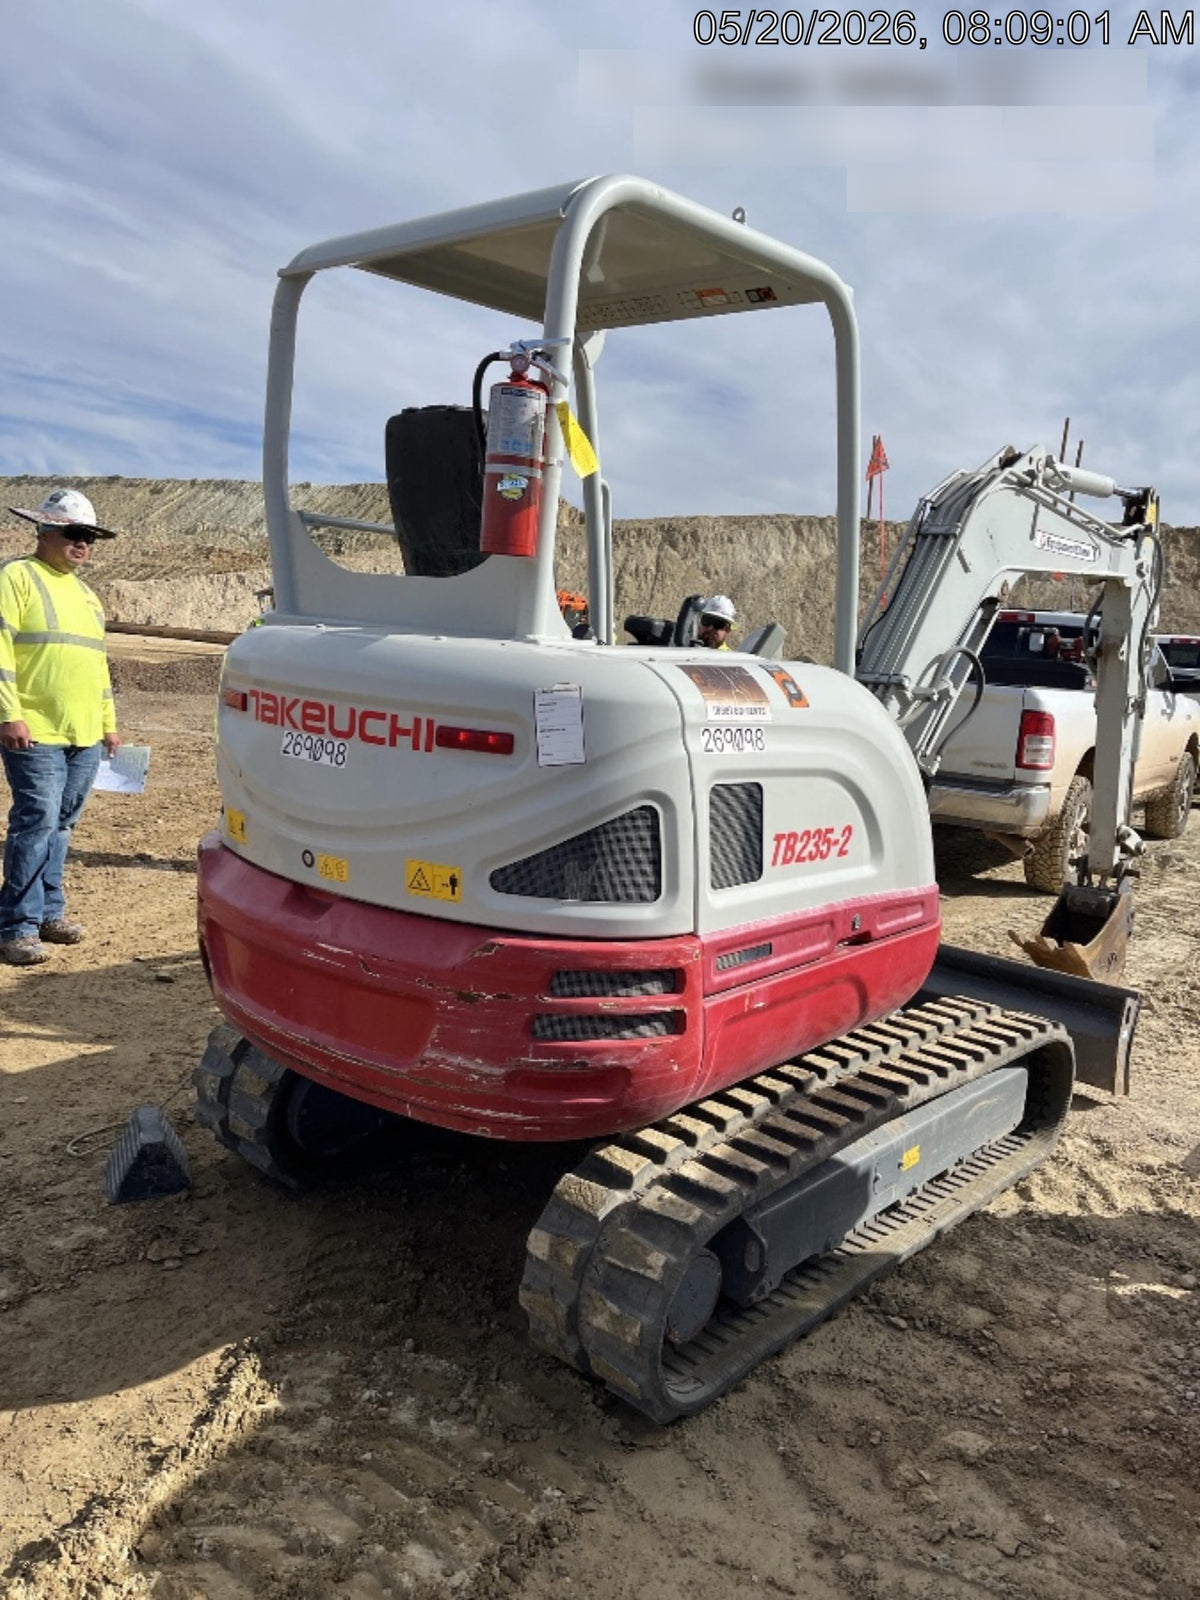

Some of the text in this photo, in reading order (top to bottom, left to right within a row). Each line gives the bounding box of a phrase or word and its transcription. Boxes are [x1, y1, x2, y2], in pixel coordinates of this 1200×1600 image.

[282, 731, 348, 766] 269098
[702, 727, 766, 753] 269098
[771, 824, 853, 867] TB235-2
